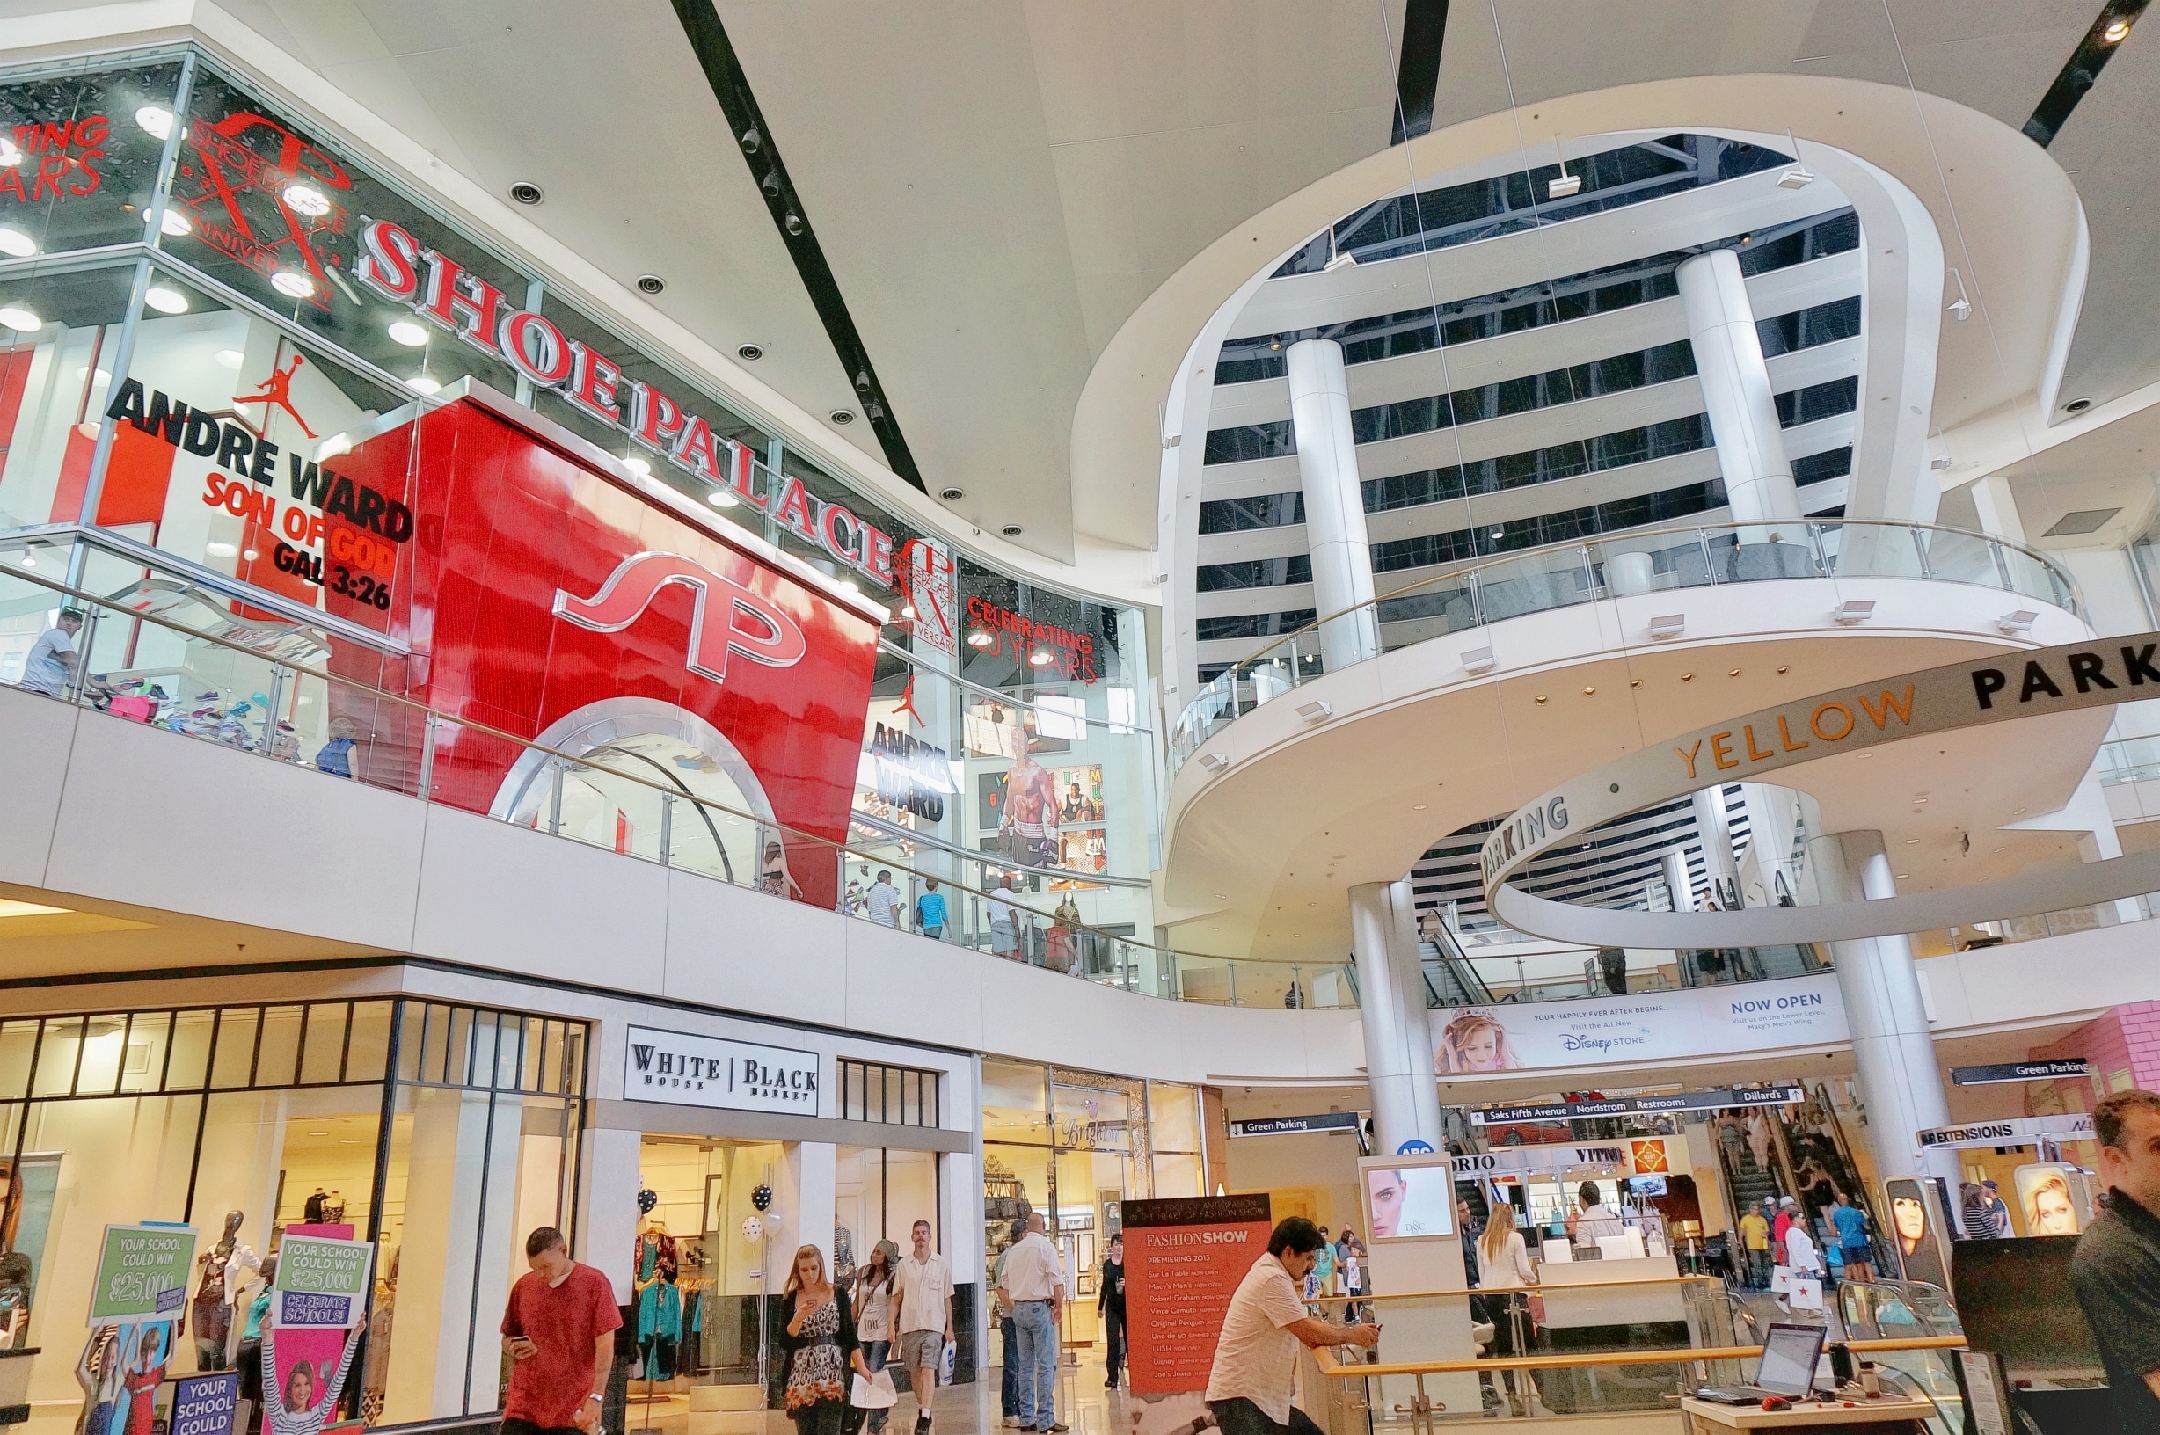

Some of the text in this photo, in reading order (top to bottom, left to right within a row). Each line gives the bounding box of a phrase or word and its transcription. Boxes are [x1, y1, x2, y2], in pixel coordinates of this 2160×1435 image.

[352, 217, 895, 588] SHOE PALACE
[106, 377, 413, 543] ANDRE WARD
[202, 472, 398, 578] SON OF GOD
[273, 542, 391, 611] GAL 3:26
[967, 596, 1093, 654] CELEBRATING
[1009, 634, 1096, 684] YEARS
[1673, 644, 2160, 778] YELLOW PARK
[871, 721, 946, 783] ANDRE
[874, 756, 944, 822] WARD
[1482, 796, 1568, 885] PARKING
[1731, 994, 1822, 1014] NOW OPEN
[1571, 1023, 1588, 1031] Visit
[1613, 1036, 1645, 1045] STORE
[2016, 1062, 2089, 1075] Green Parking
[644, 1074, 808, 1102] HOUSE MARKET
[1490, 1089, 1782, 1119] Saks Fifth Avenue Nordstrom Restrooms Dillard's
[1062, 1118, 1120, 1147] Brighton
[1247, 1120, 1308, 1132] Green Parking
[1937, 1125, 2013, 1143] EXTENSIONS
[120, 1237, 182, 1251] YOUR SCHOOL
[287, 1243, 365, 1260] YOUR SCHOOL
[122, 1253, 174, 1266] COULD WIN
[292, 1256, 357, 1271] COULD WIN
[109, 1271, 175, 1306] $25,000
[291, 1268, 352, 1291] $25,000
[287, 1294, 348, 1310] CELEBRATE
[189, 1380, 227, 1398] YOUR
[178, 1396, 233, 1419] SCHOOL
[180, 1416, 227, 1435] COULD
